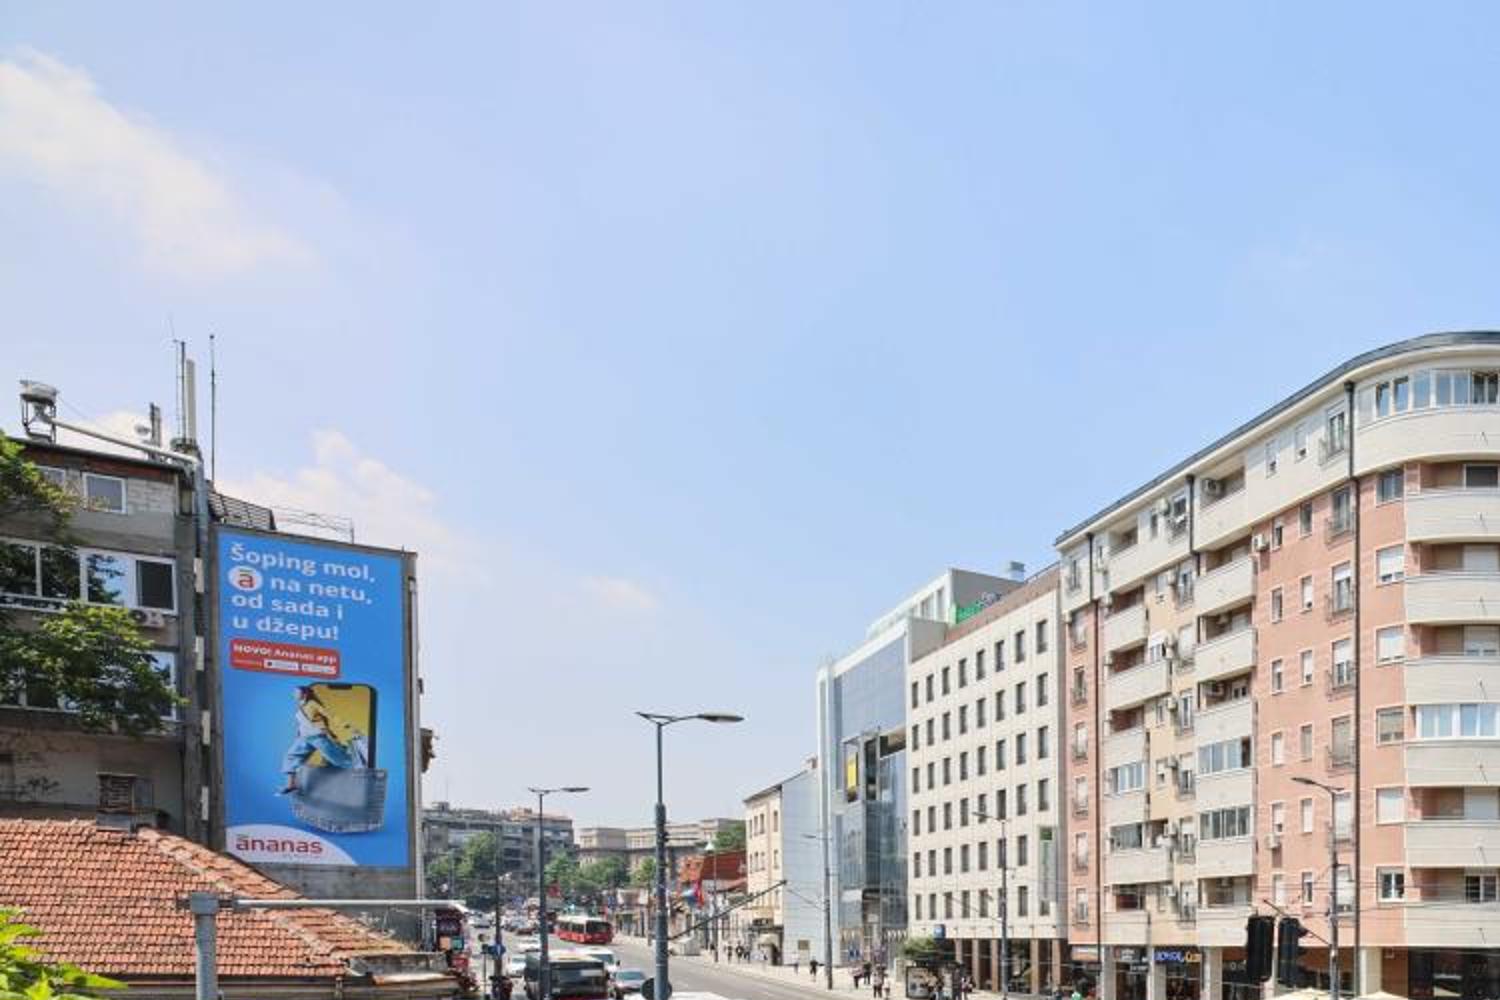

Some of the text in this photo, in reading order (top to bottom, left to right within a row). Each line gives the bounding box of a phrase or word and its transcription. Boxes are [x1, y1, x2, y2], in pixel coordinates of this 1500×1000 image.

[230, 542, 317, 576] Šoping
[270, 577, 301, 593] na
[231, 593, 344, 621] od sada i
[232, 615, 339, 641] u džepu!
